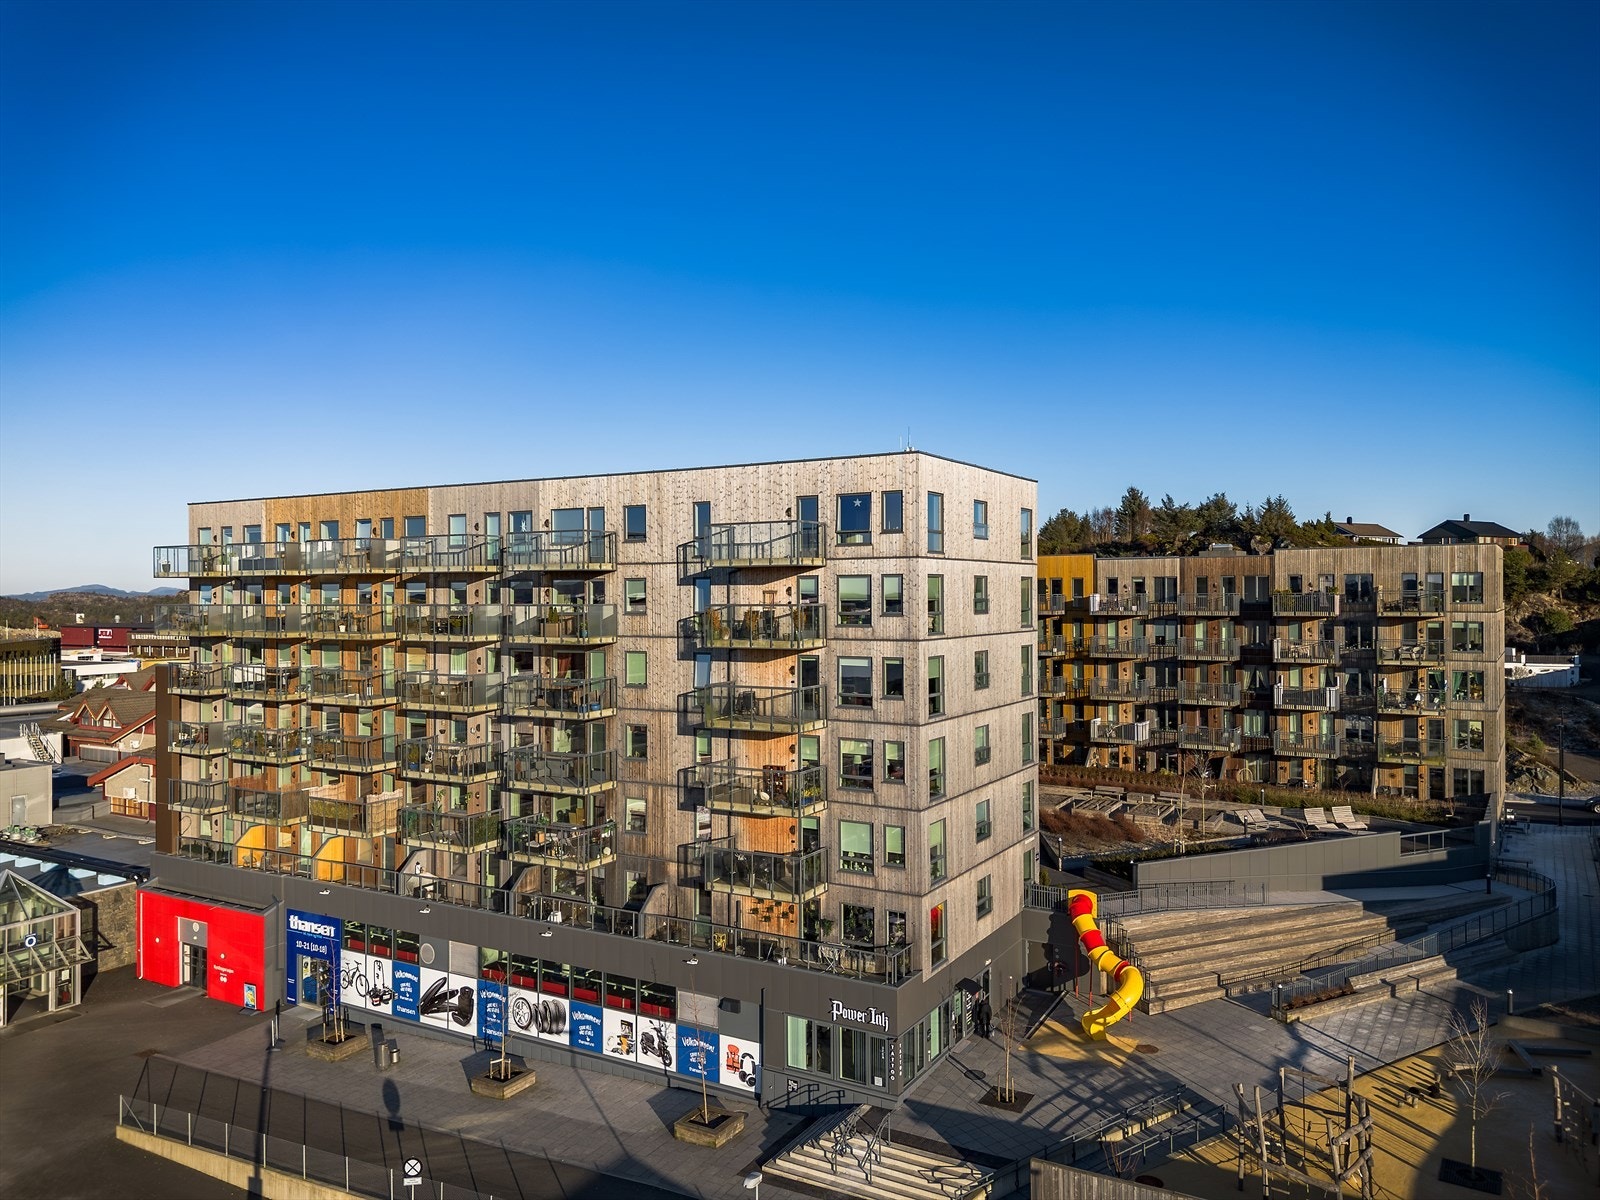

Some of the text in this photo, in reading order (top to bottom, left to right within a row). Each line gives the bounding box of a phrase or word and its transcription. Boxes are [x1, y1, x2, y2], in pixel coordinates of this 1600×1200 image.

[289, 914, 336, 937] thansen
[296, 940, 310, 950] 10-21
[396, 1005, 415, 1015] thansen
[831, 1000, 890, 1032] Power Ink
